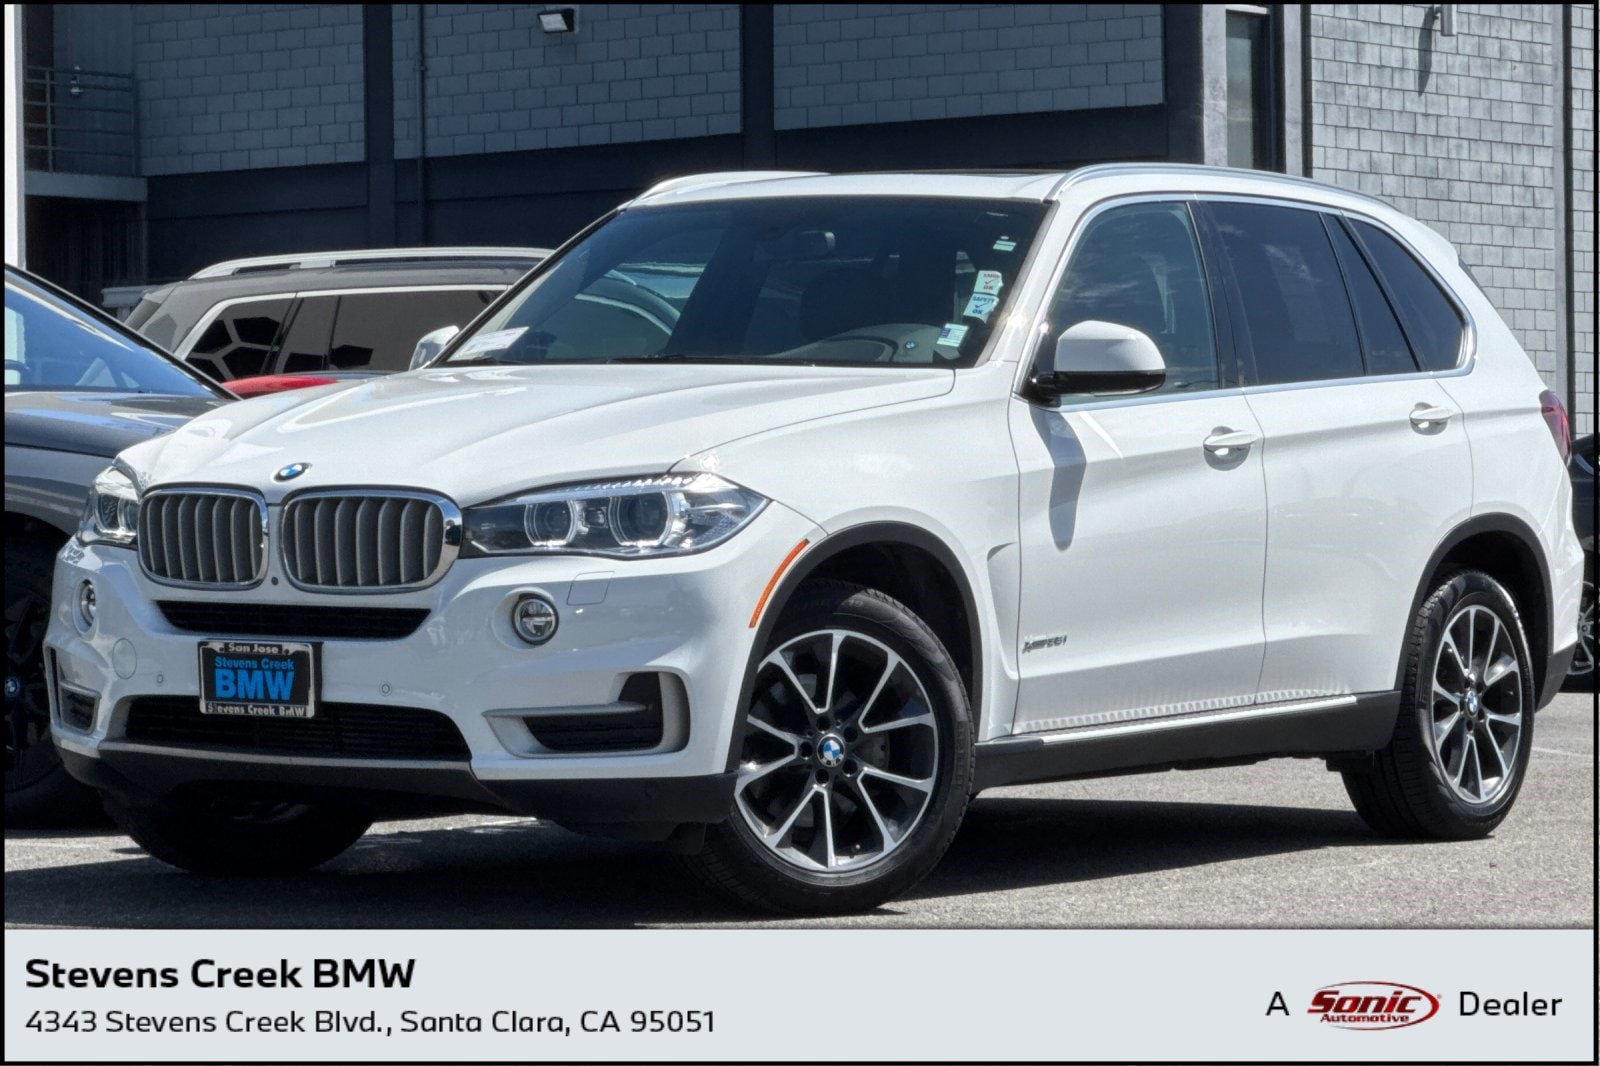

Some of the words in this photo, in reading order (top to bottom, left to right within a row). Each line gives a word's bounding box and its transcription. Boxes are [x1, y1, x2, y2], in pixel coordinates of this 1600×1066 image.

[228, 642, 251, 653] San
[252, 643, 279, 654] Jose
[215, 656, 258, 669] Stevens
[261, 657, 295, 670] Creek
[215, 669, 295, 701] BMW
[247, 704, 275, 716] Creek
